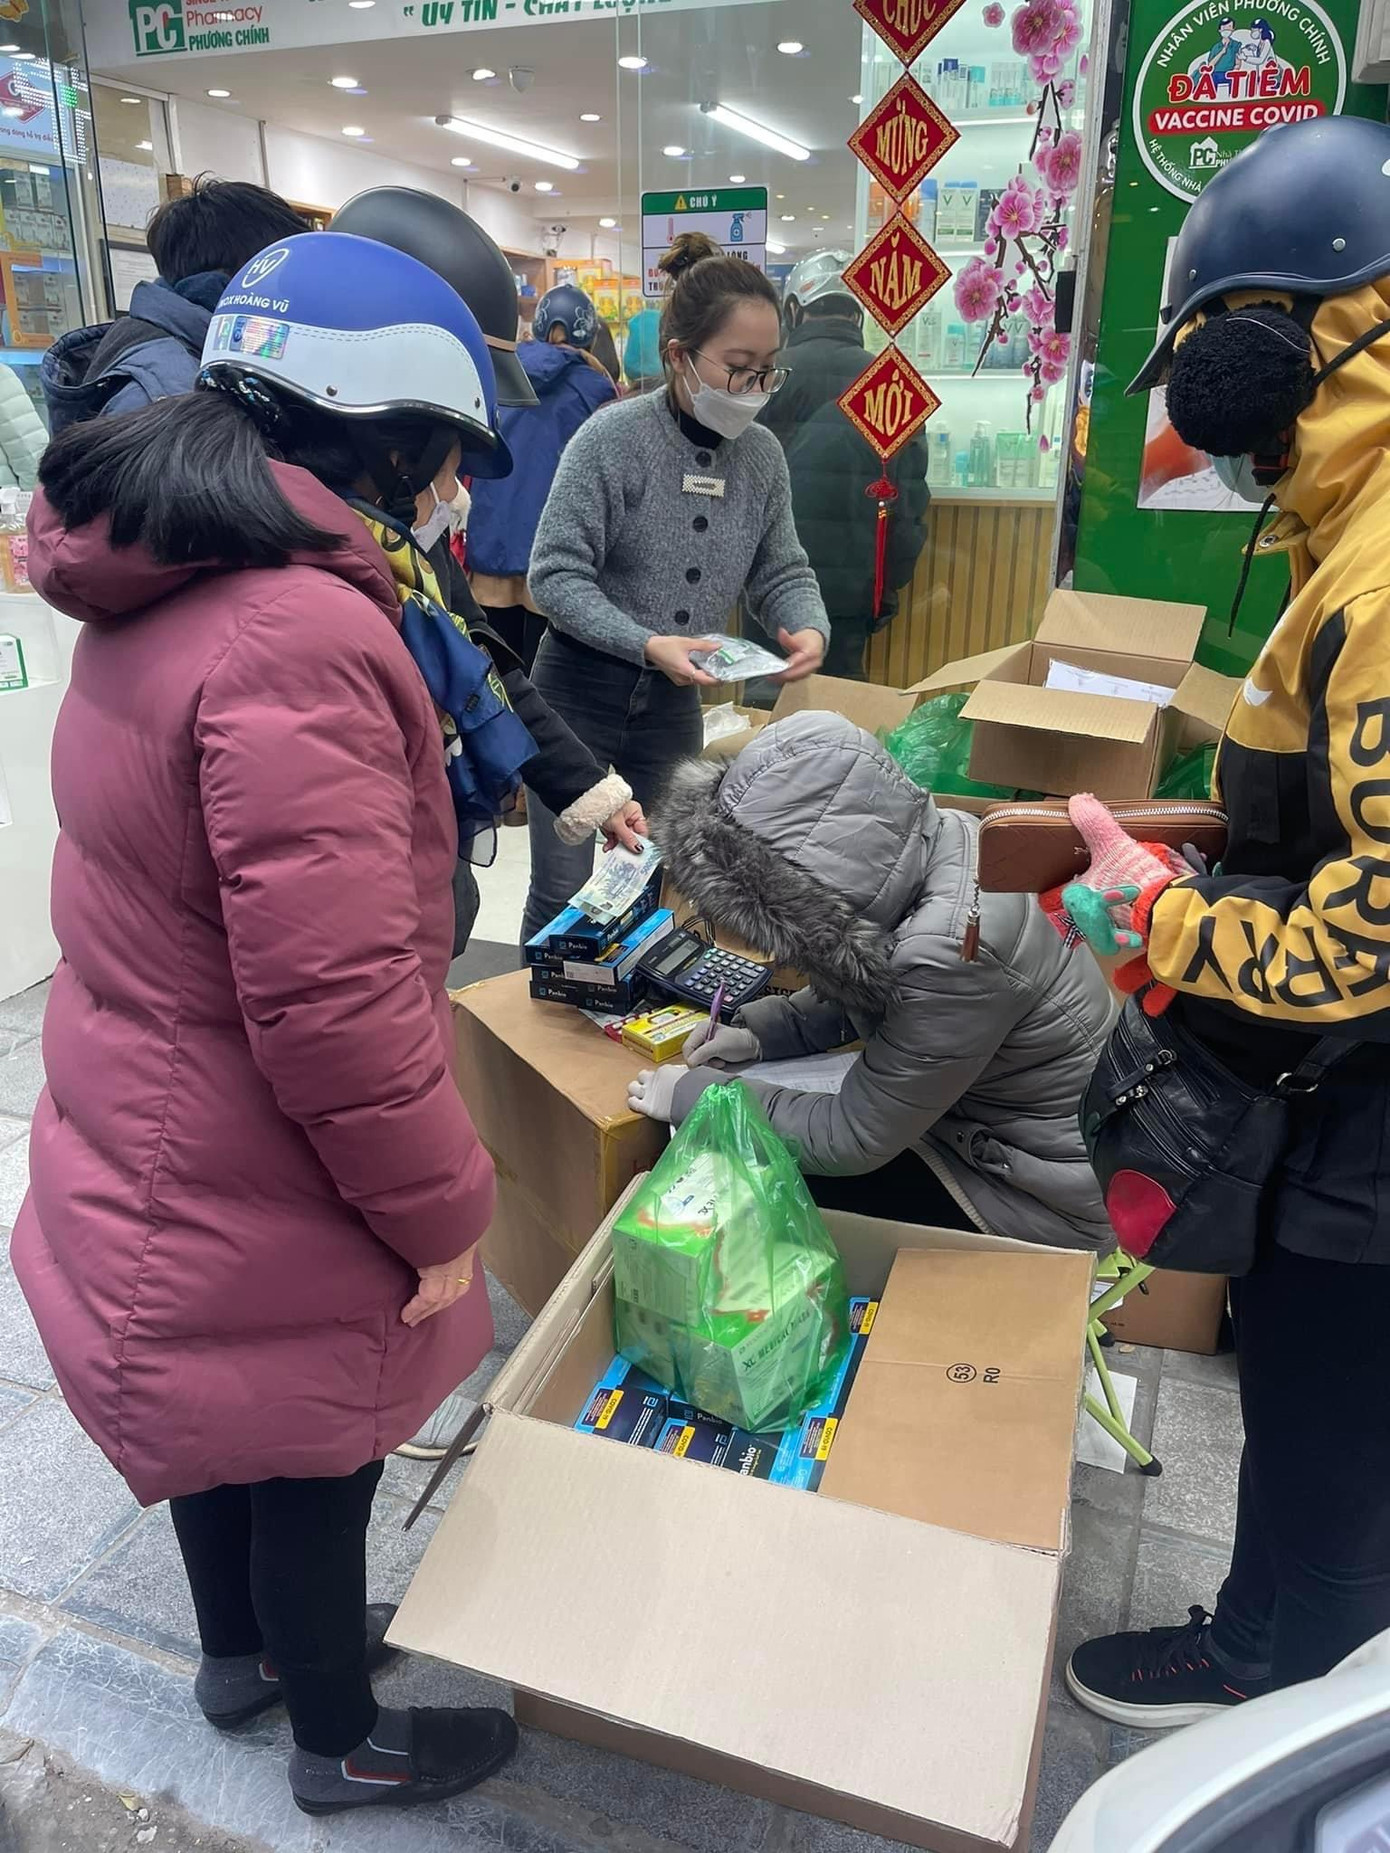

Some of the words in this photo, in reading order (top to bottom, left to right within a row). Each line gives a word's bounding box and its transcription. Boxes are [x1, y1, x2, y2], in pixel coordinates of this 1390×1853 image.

[136, 4, 183, 52] PC
[186, 6, 263, 27] Pharmacy
[189, 28, 233, 51] PHƯƠNG
[235, 25, 270, 46] CHÍNH
[1157, 23, 1194, 67] NHÂN
[1193, 1, 1229, 27] VIÊN
[1233, 0, 1299, 22] PHƯƠNG
[1298, 17, 1331, 65] CHÍNH
[1168, 65, 1217, 103] ĐÃ
[1226, 60, 1311, 99] TIÊM
[1154, 108, 1245, 131] VACCINE
[1249, 105, 1319, 126] COVID
[875, 97, 929, 176] MỪNG
[1149, 138, 1162, 154] HỆ
[1156, 152, 1183, 182] THỐNG
[1181, 177, 1202, 193] NHÀ
[869, 233, 923, 310] NĂM
[233, 291, 270, 309] HOÀNG
[273, 299, 290, 313] VŨ
[863, 370, 913, 437] MỚI
[953, 1366, 971, 1380] 53
[675, 1433, 690, 1457] COVID-
[819, 1426, 834, 1454] COVID-19
[739, 1443, 757, 1475] anbio
